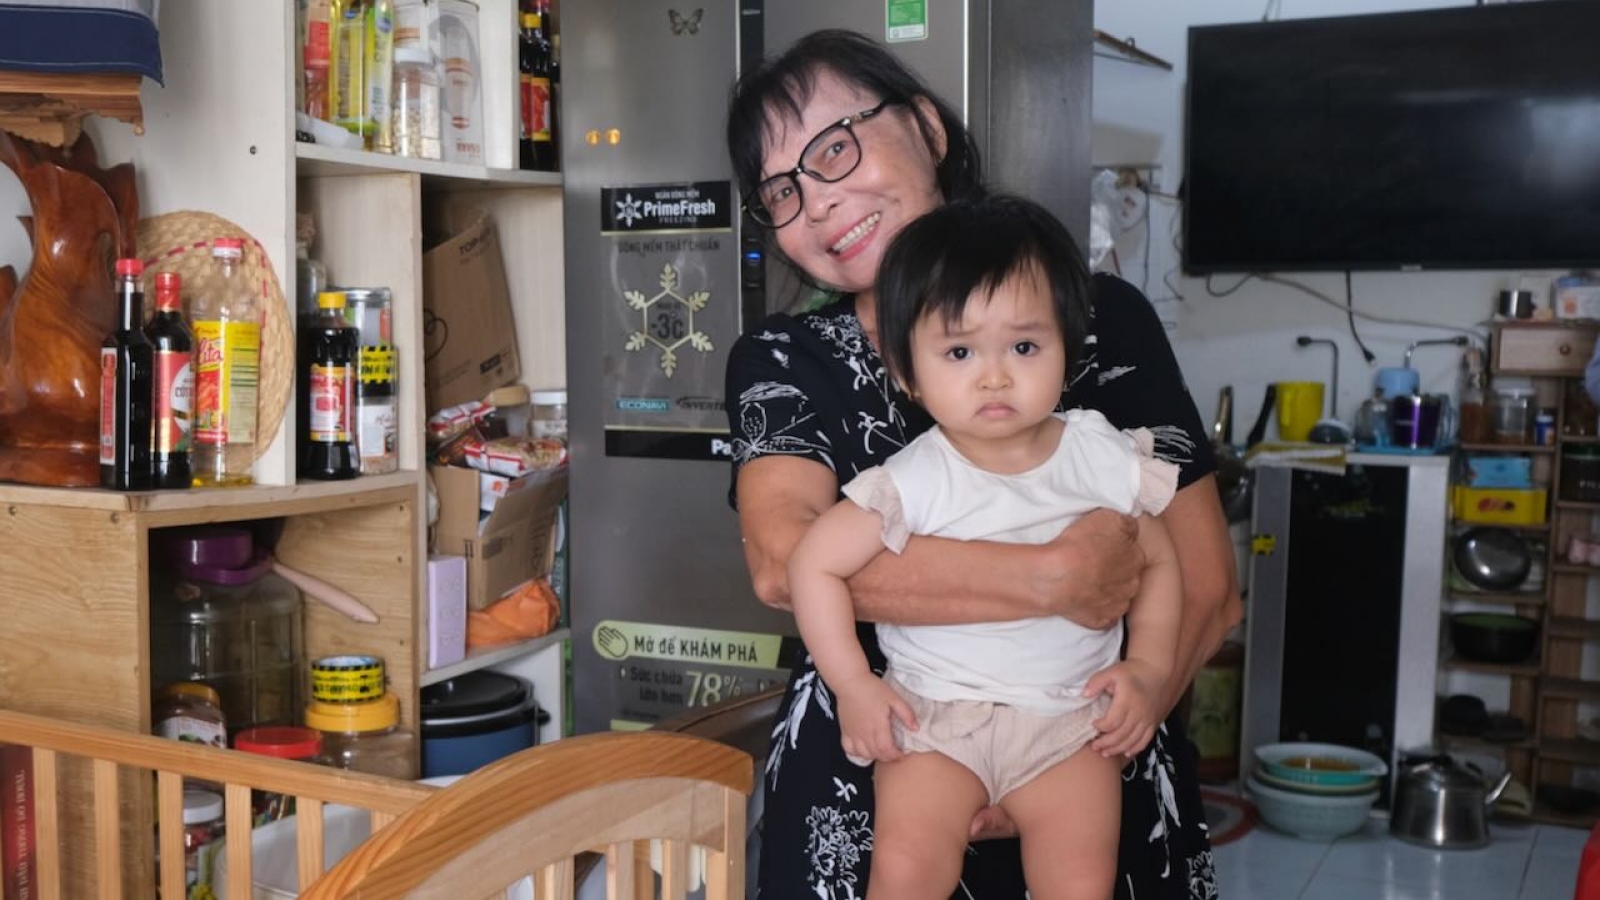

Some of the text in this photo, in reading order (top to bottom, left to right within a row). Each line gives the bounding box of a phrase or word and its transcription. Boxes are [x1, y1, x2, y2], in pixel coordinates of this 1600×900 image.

[643, 199, 716, 218] PrimeFresh
[680, 638, 722, 660] KHÁM
[728, 640, 759, 663] PHÁ
